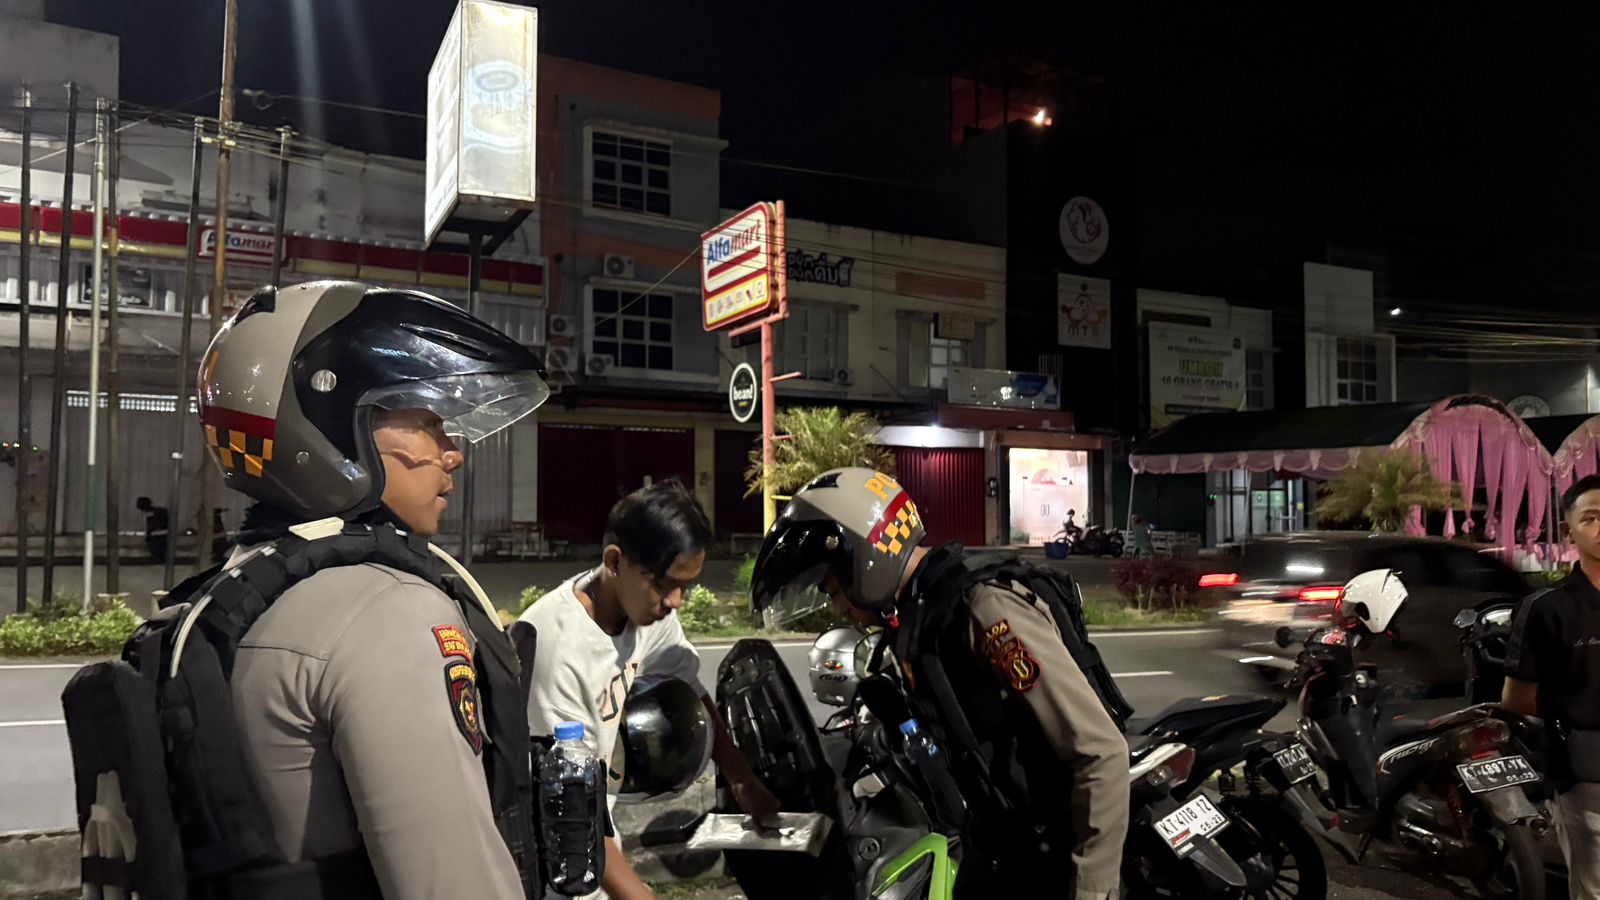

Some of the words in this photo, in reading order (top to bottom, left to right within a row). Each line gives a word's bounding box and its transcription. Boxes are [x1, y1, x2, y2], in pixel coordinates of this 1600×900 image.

[707, 219, 761, 264] Alfamart
[1160, 818, 1179, 835] KT
[1175, 807, 1198, 825] 4118
